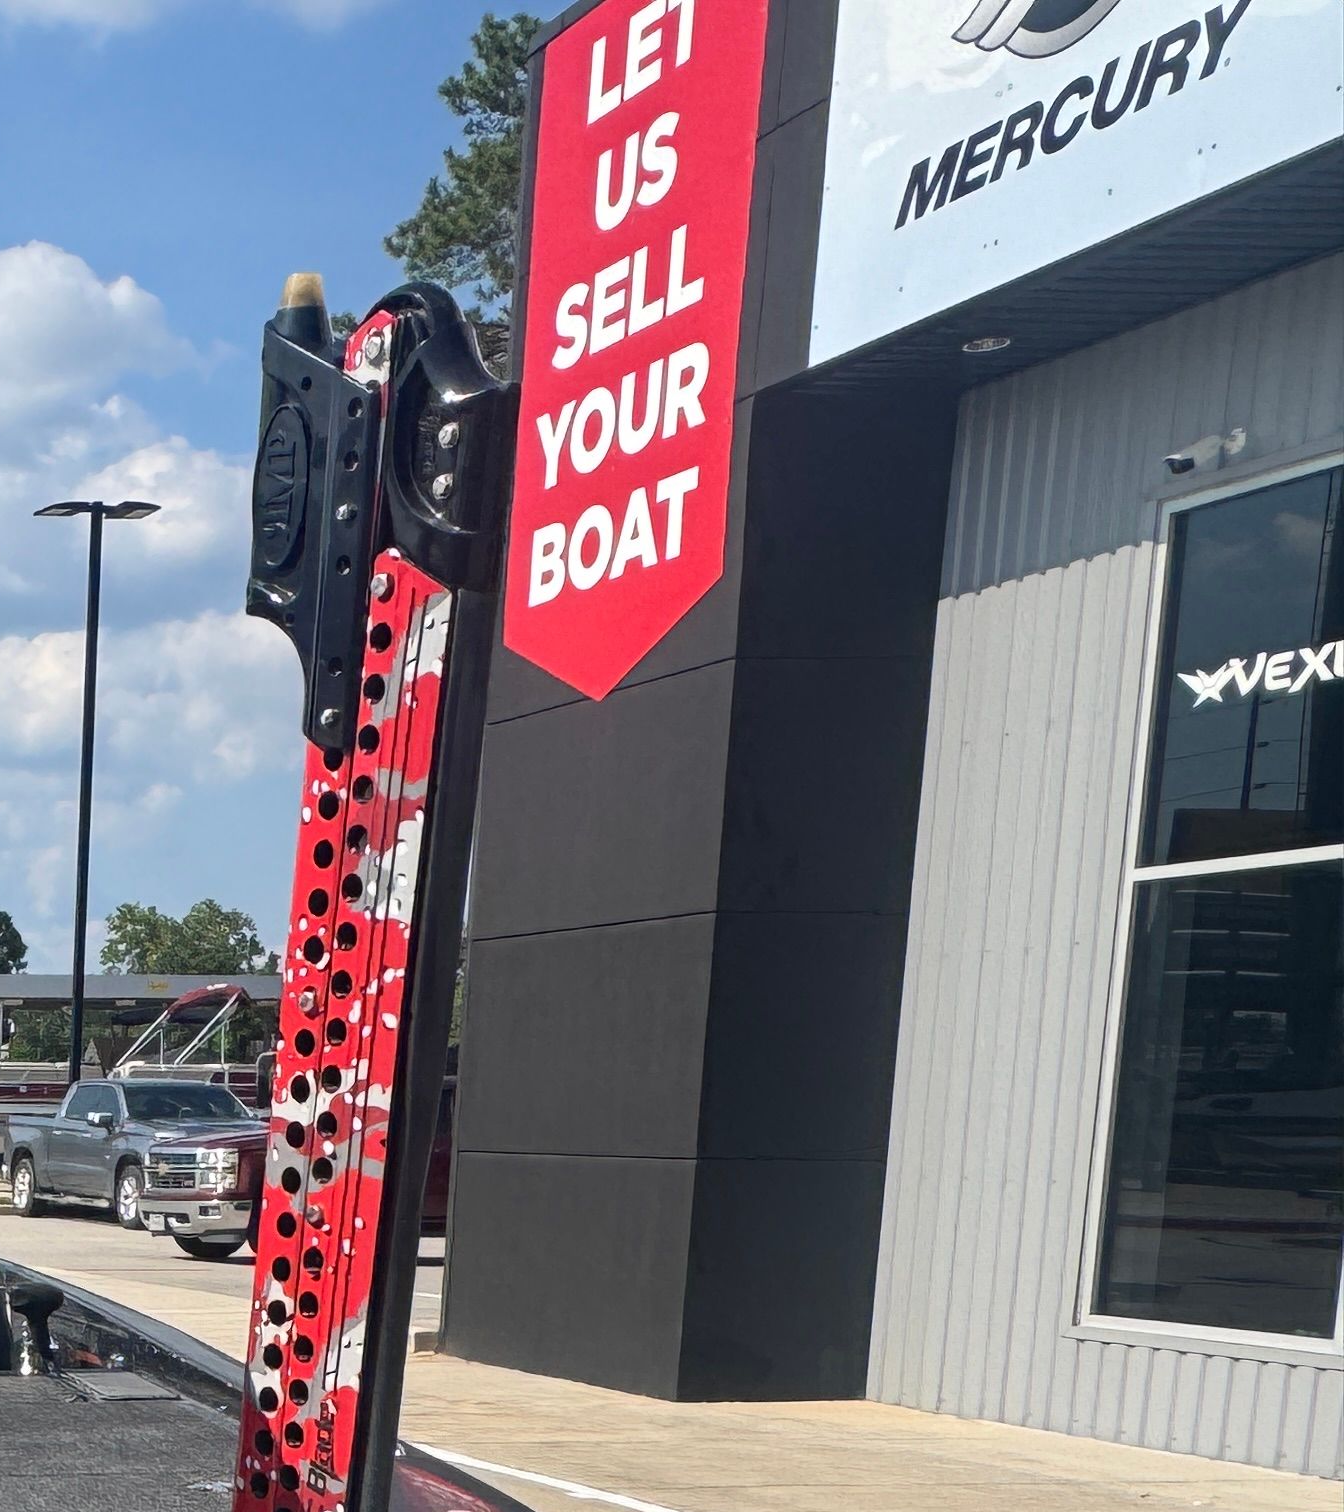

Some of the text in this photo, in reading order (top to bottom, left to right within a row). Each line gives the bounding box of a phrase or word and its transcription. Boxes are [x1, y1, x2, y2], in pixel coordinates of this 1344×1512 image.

[587, 0, 695, 125] LET
[894, 0, 1252, 231] MERCURY
[594, 111, 680, 231] US
[551, 225, 705, 370] SELL
[536, 342, 710, 490] YOUR
[528, 466, 700, 608] BOAT
